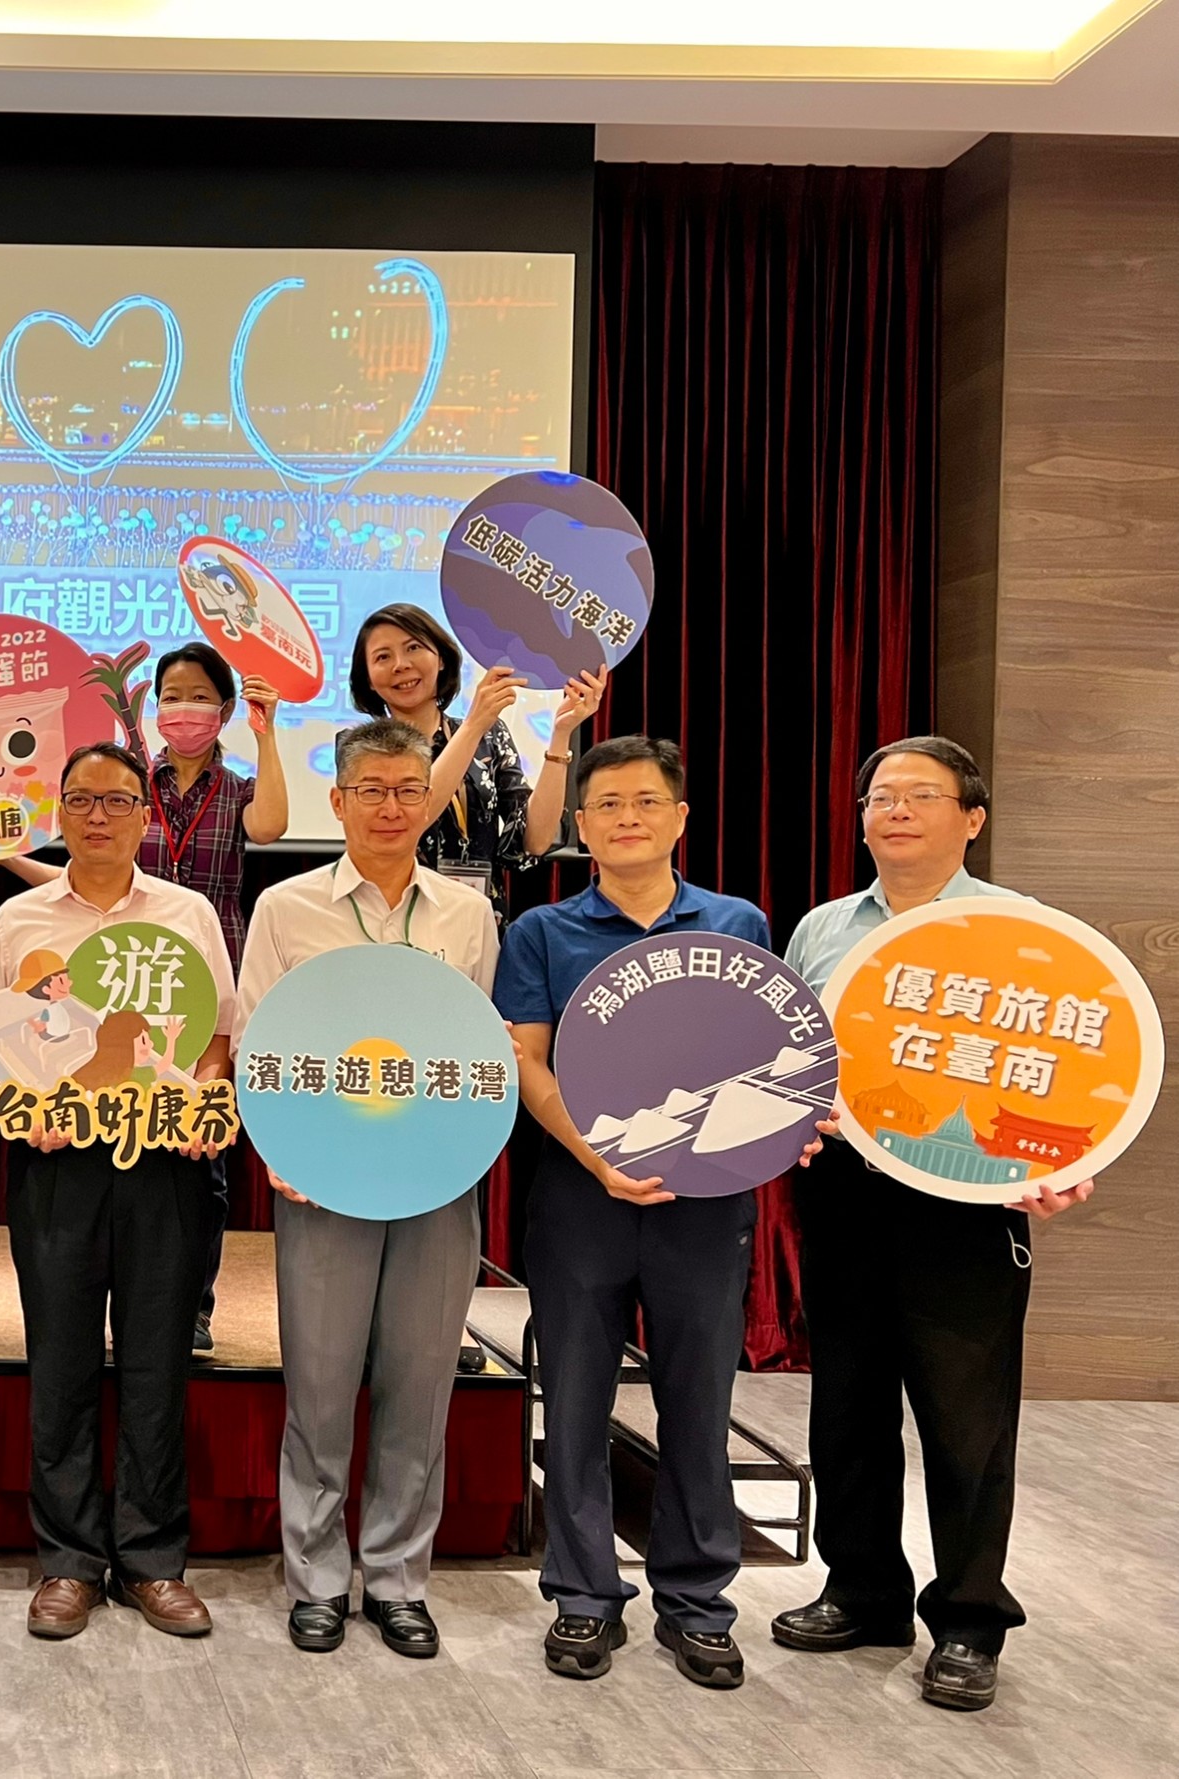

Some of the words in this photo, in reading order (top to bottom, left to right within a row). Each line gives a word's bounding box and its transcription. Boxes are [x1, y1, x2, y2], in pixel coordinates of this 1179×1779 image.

[462, 514, 636, 646] 低碳活力海洋
[1, 629, 47, 648] 2022
[94, 935, 188, 1027] 遊
[581, 946, 824, 1043] 潟湖鹽田好風光
[883, 962, 1109, 1048] 優質旅館
[246, 1053, 508, 1102] 濱海遊憩港灣
[889, 1023, 1057, 1097] 在臺南
